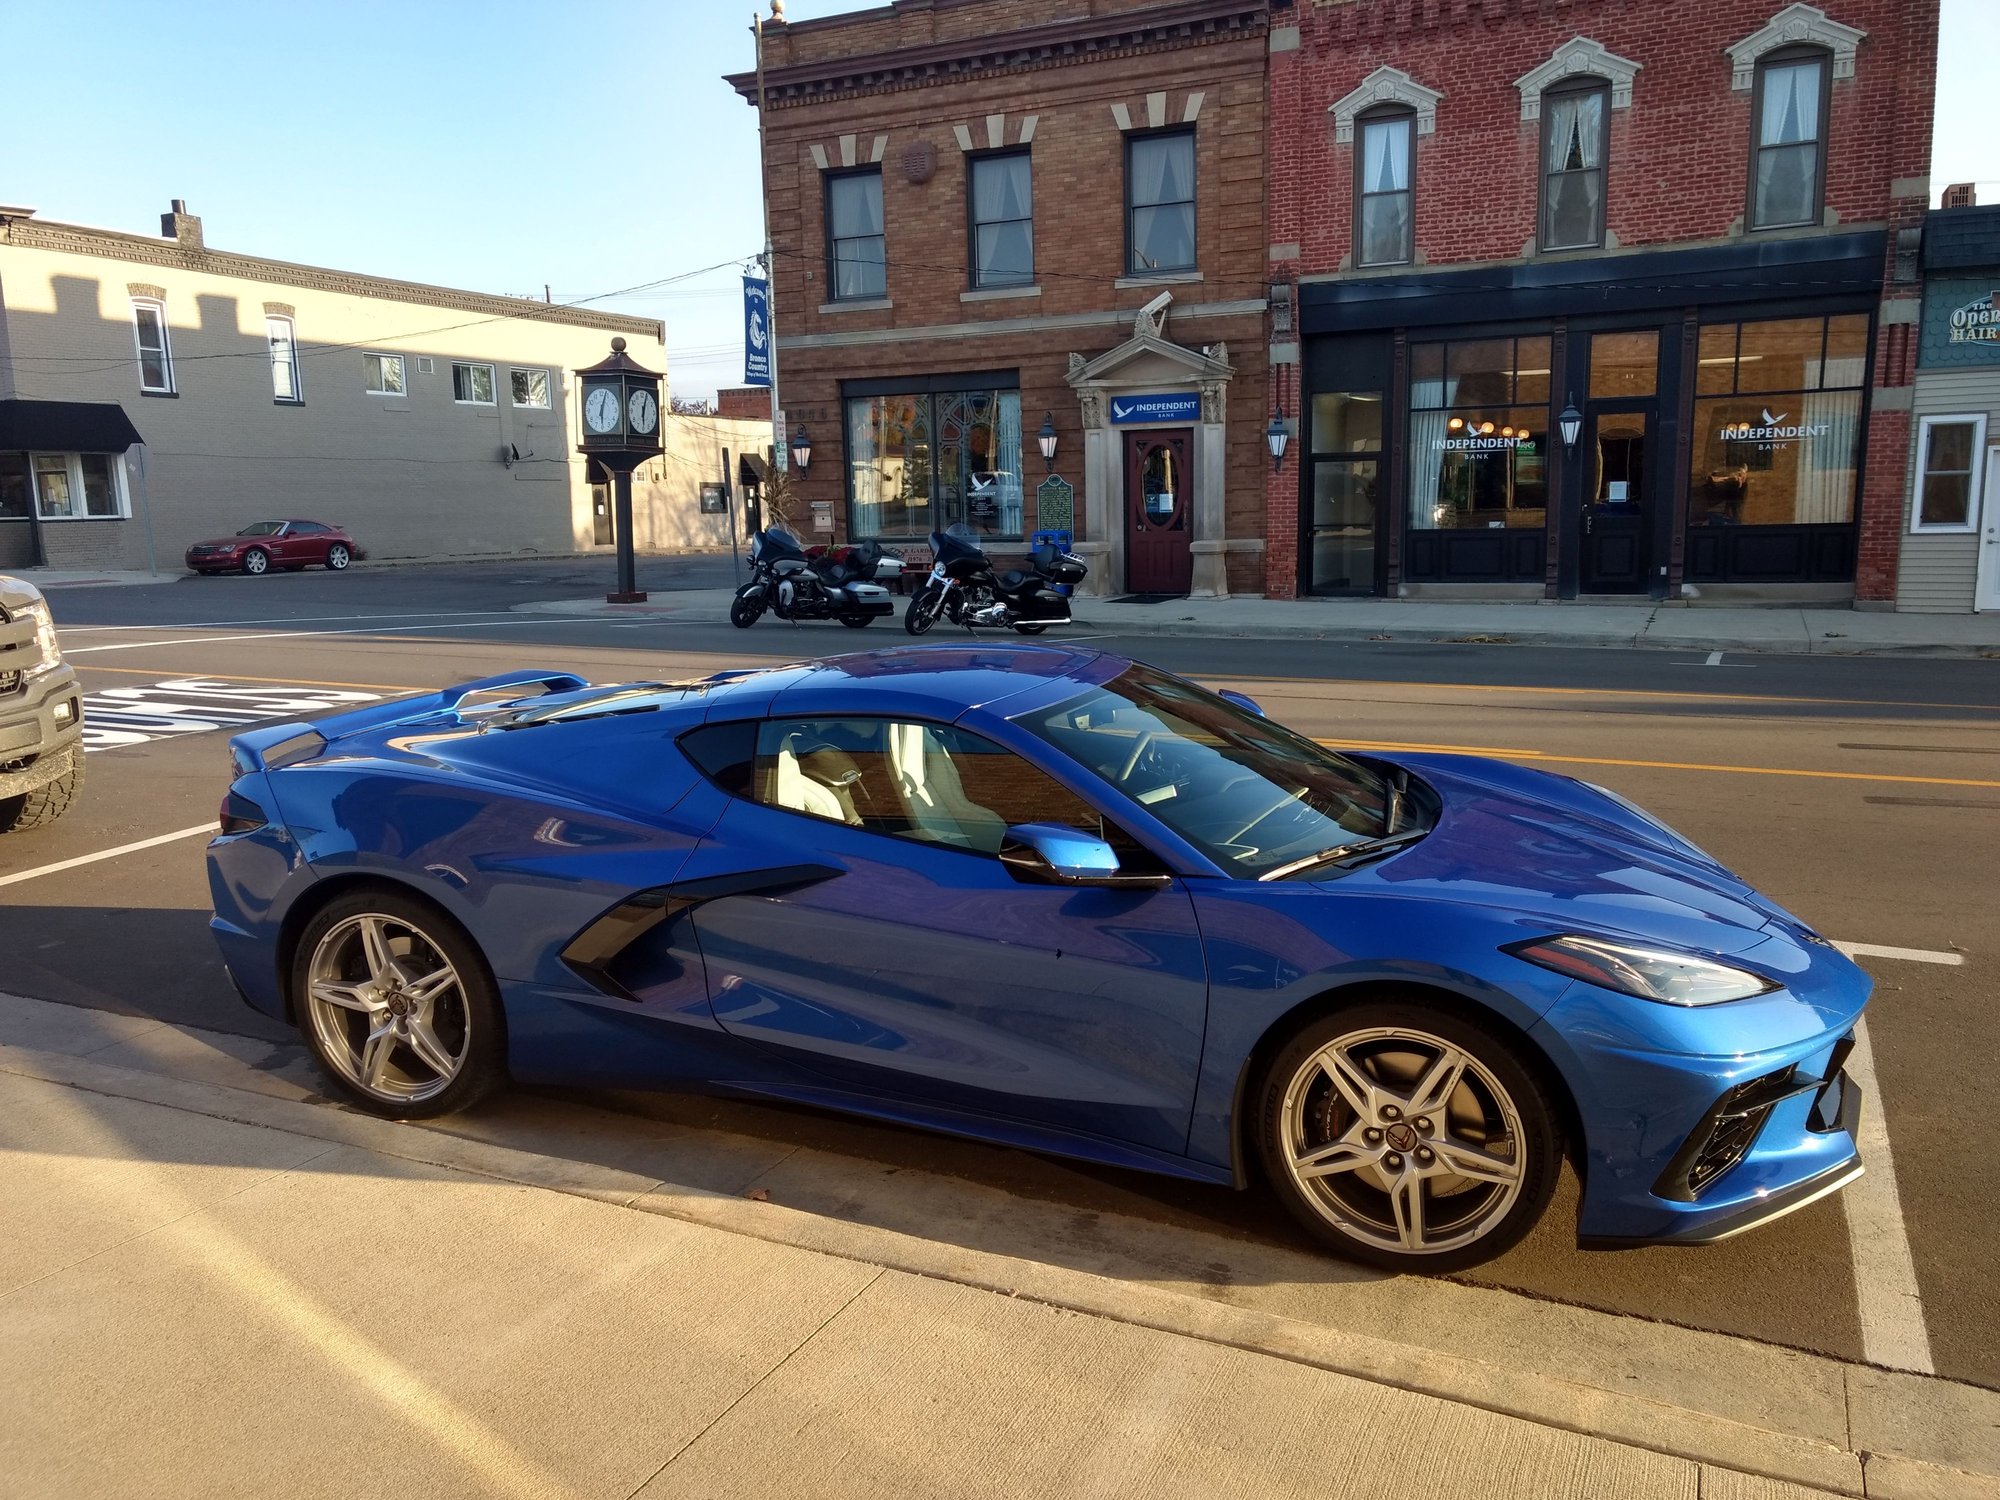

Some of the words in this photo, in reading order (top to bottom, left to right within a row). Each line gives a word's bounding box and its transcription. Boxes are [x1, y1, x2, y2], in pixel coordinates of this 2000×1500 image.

[1952, 327, 1998, 341] HAIR
[749, 353, 767, 363] Bronco
[748, 361, 767, 373] Country
[1136, 401, 1197, 412] INDEPENDENT
[1720, 425, 1829, 440] INDEPENDENT
[1432, 437, 1522, 450] INDEPENDENT
[1758, 443, 1787, 451] BANK
